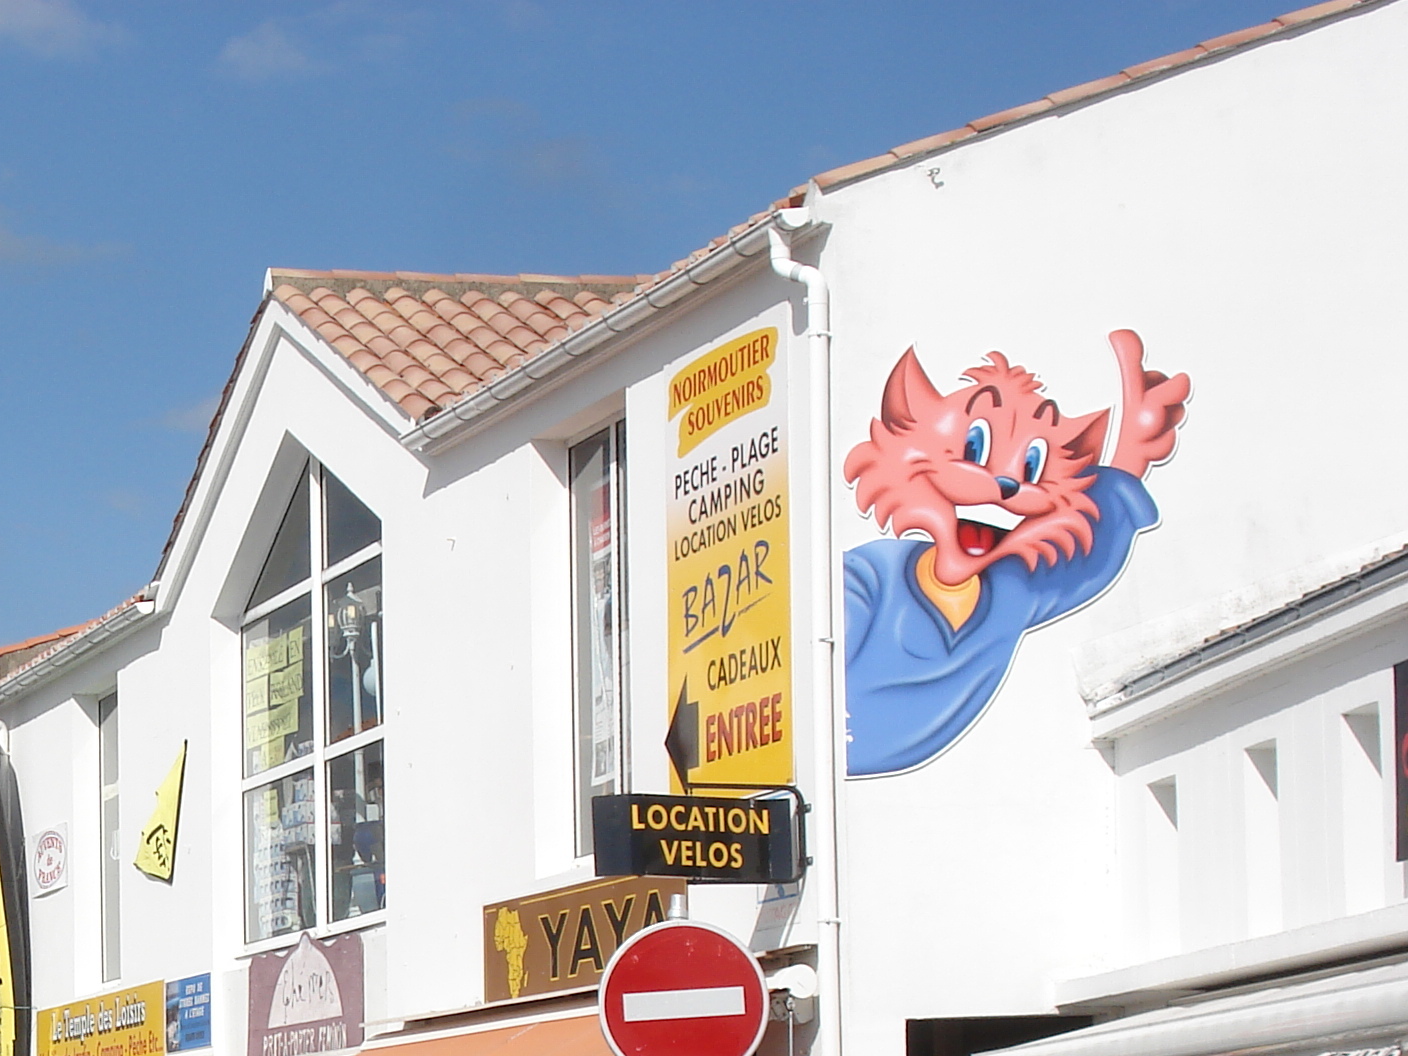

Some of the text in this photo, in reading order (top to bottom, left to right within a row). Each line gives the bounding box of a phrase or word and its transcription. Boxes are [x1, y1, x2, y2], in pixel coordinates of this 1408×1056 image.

[673, 334, 770, 408] NOIRMOUTIER
[688, 375, 764, 436] SOUVENIRS
[675, 426, 779, 500] PECHE PLAGE
[674, 494, 782, 561] LOCATION VELOS
[688, 468, 765, 526] CAMPING
[682, 539, 773, 638] BAZAR
[707, 636, 782, 691] CADEAUX
[705, 692, 783, 763] ENTREE
[631, 804, 770, 834] LOCATION
[660, 839, 743, 868] VELOS
[52, 1011, 62, 1043] Le
[63, 1005, 95, 1045] Temple
[98, 1000, 113, 1034] des
[115, 992, 146, 1031] Loisirs
